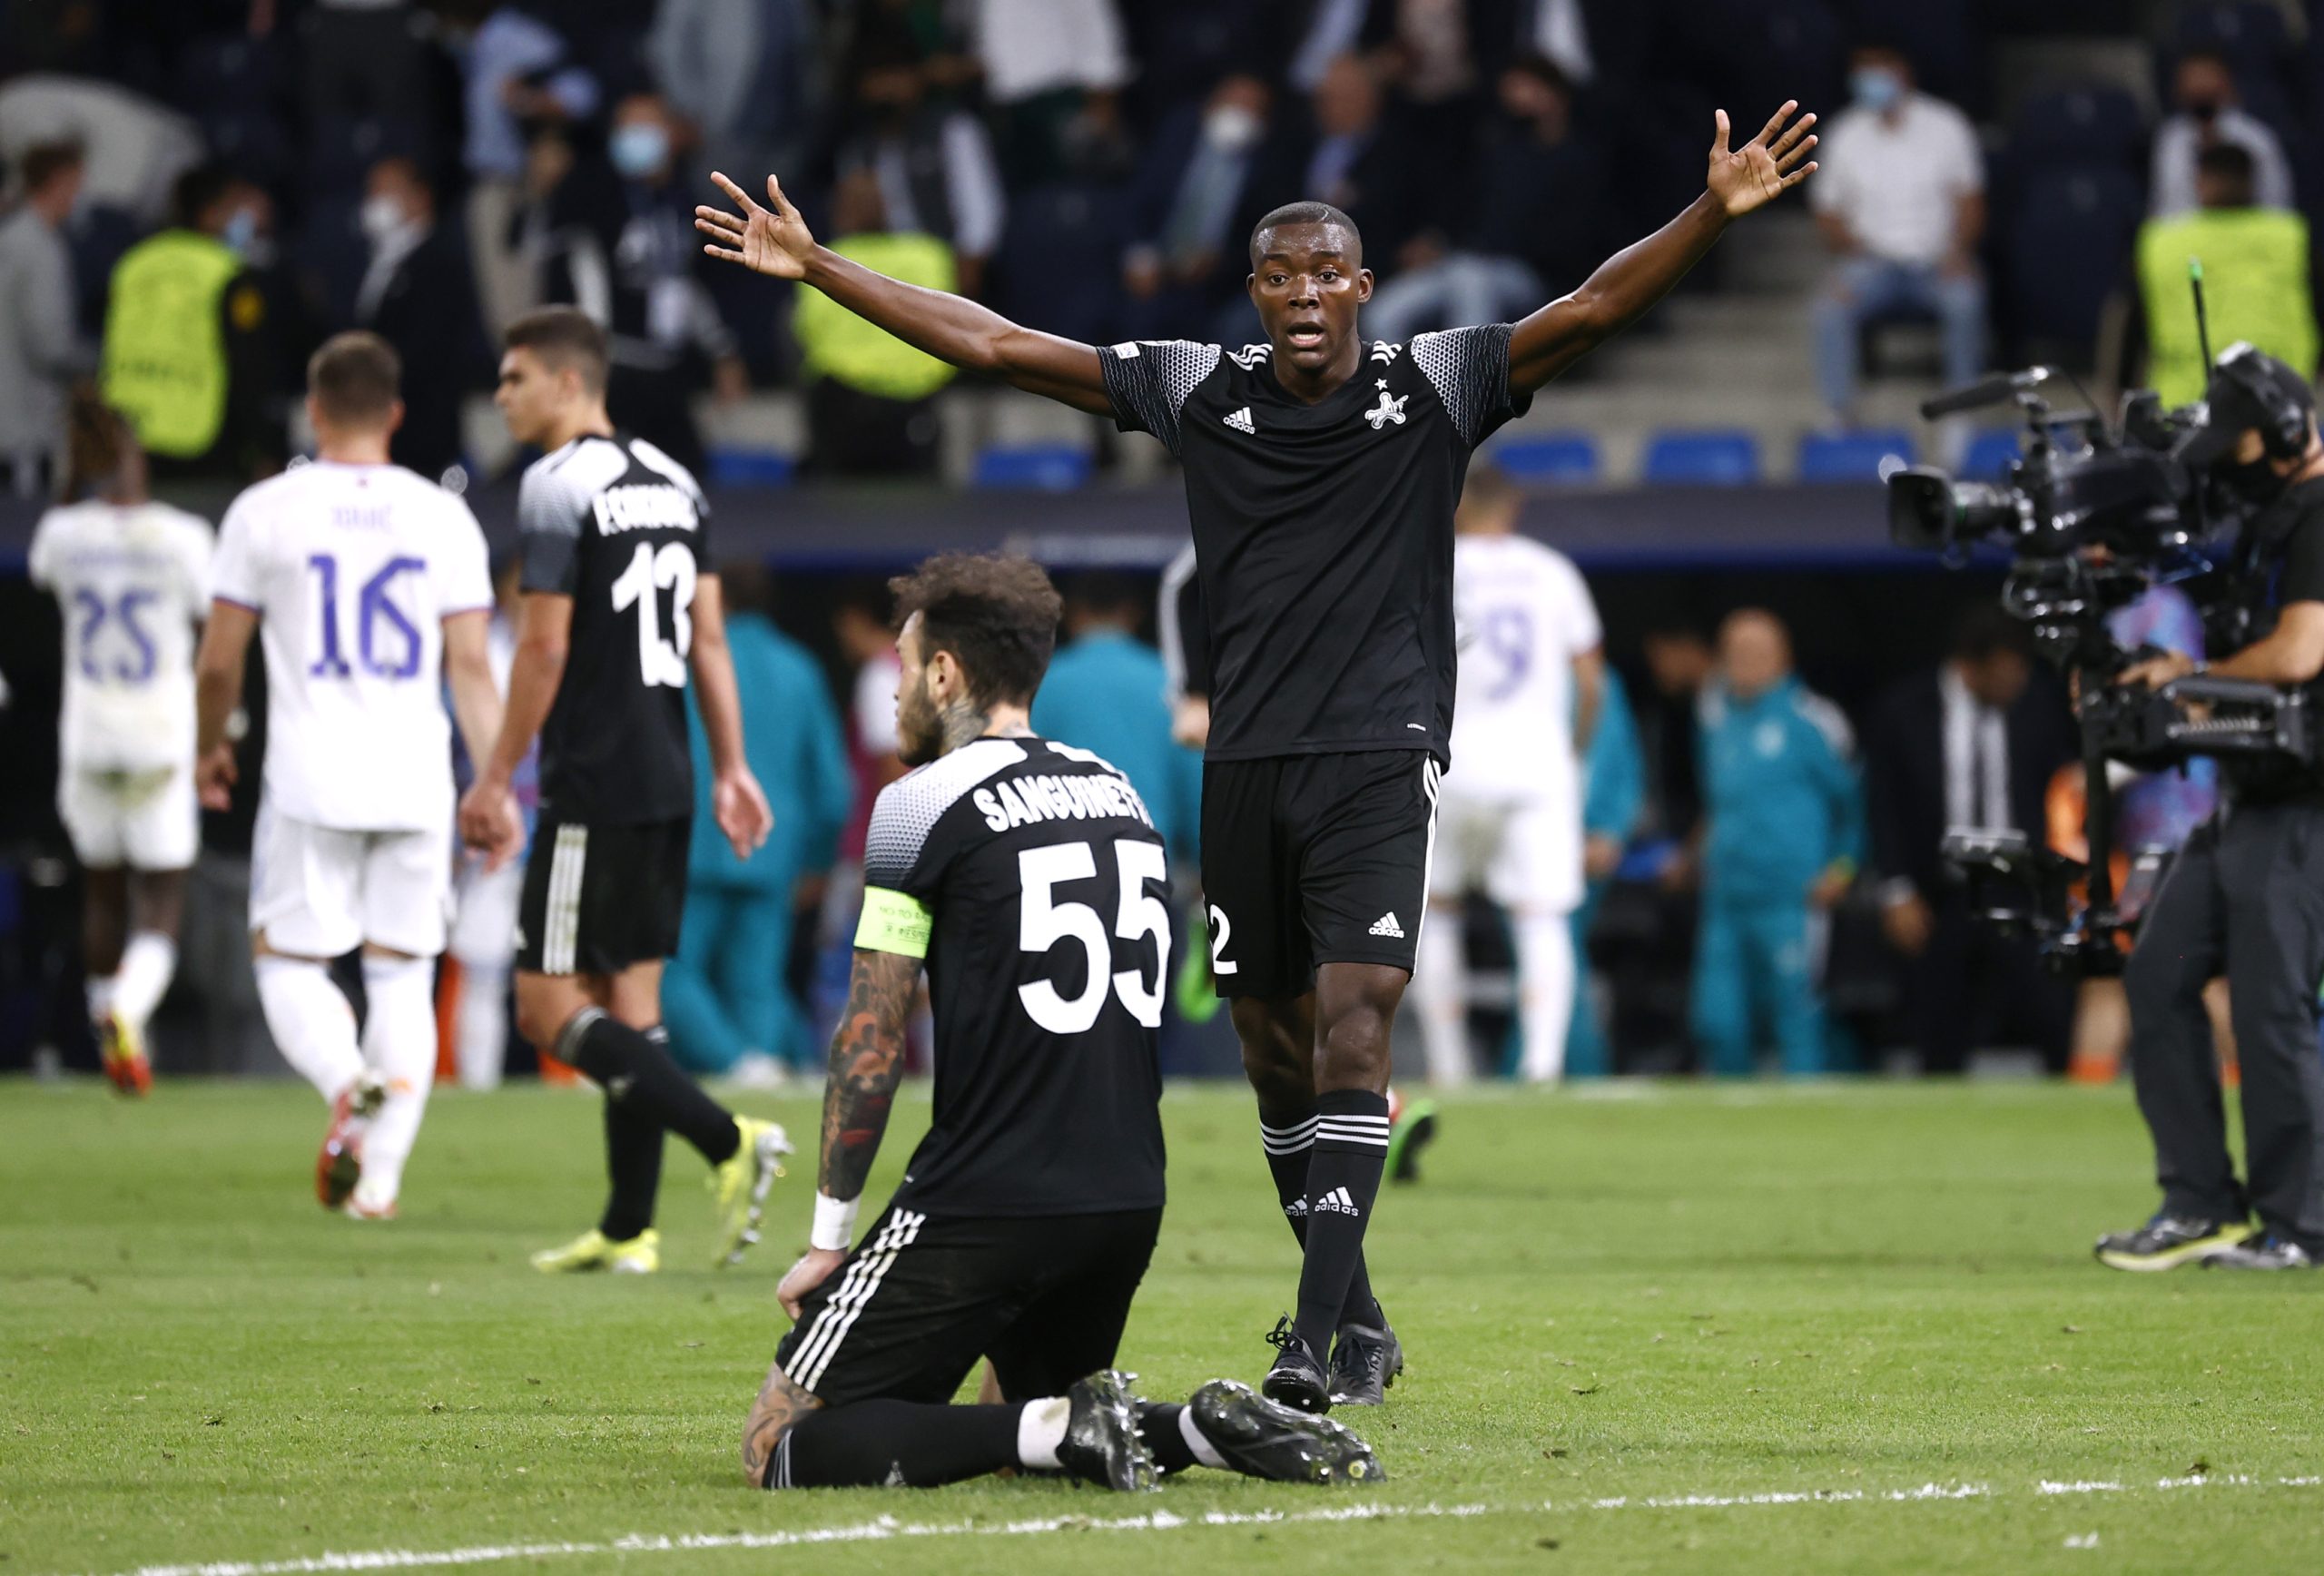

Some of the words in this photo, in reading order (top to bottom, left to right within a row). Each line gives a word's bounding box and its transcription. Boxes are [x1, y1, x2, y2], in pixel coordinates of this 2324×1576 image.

[1223, 416, 1256, 435] adidas
[75, 586, 160, 685] 25
[309, 555, 427, 677] 16
[611, 540, 698, 689] 13
[1017, 838, 1173, 1034] 55
[1203, 893, 1238, 975] 2
[1368, 926, 1404, 939] adidas
[1315, 1203, 1359, 1216] adidas
